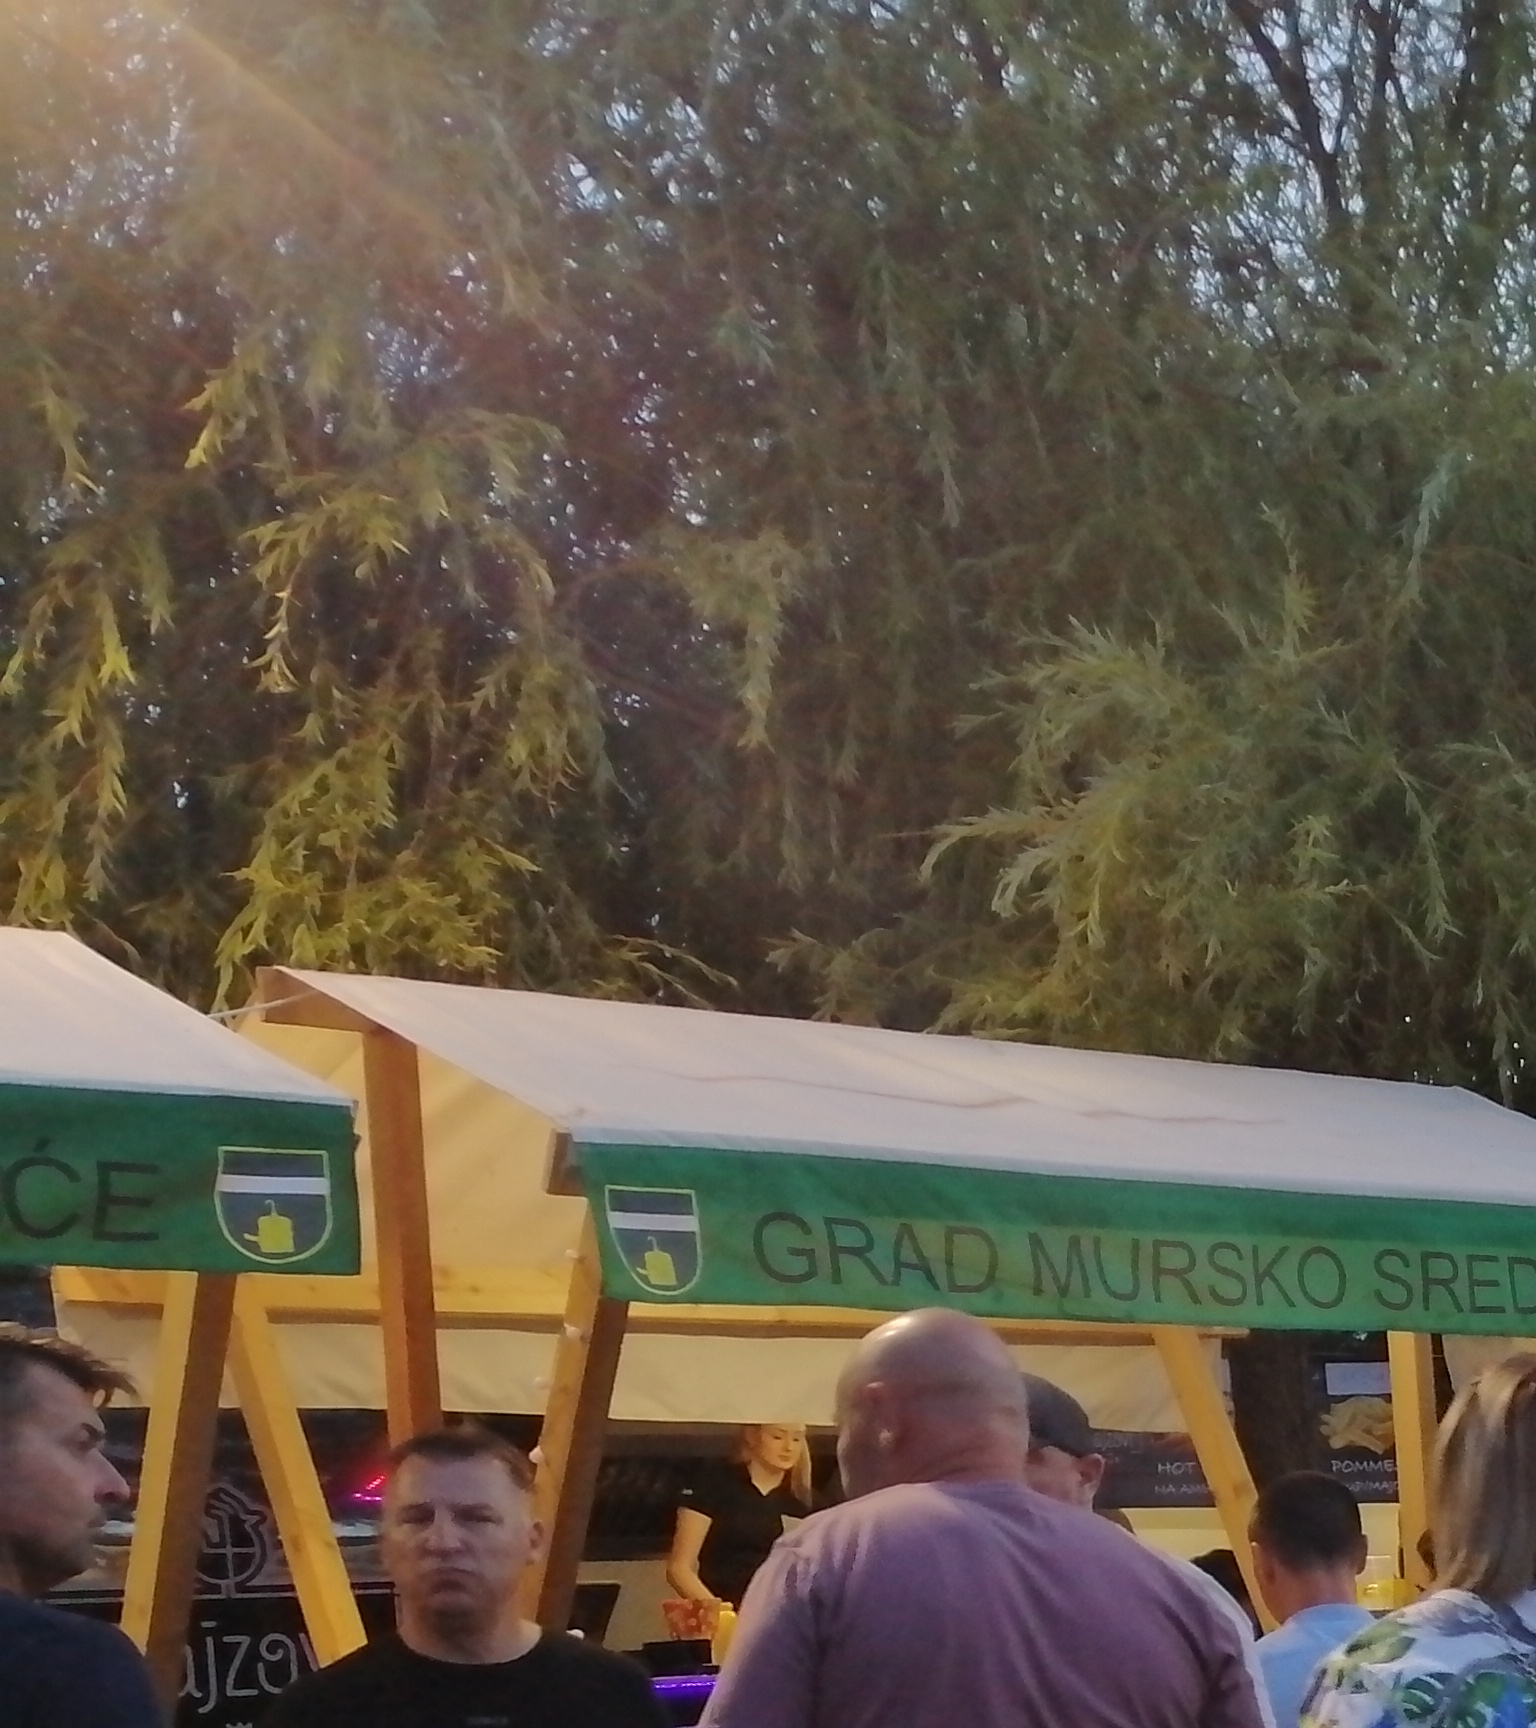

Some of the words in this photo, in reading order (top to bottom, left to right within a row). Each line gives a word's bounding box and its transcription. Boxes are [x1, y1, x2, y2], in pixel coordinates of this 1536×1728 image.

[752, 1211, 999, 1294] GRAD
[1028, 1231, 1347, 1309] MURSKO
[1158, 1462, 1196, 1475] HOT
